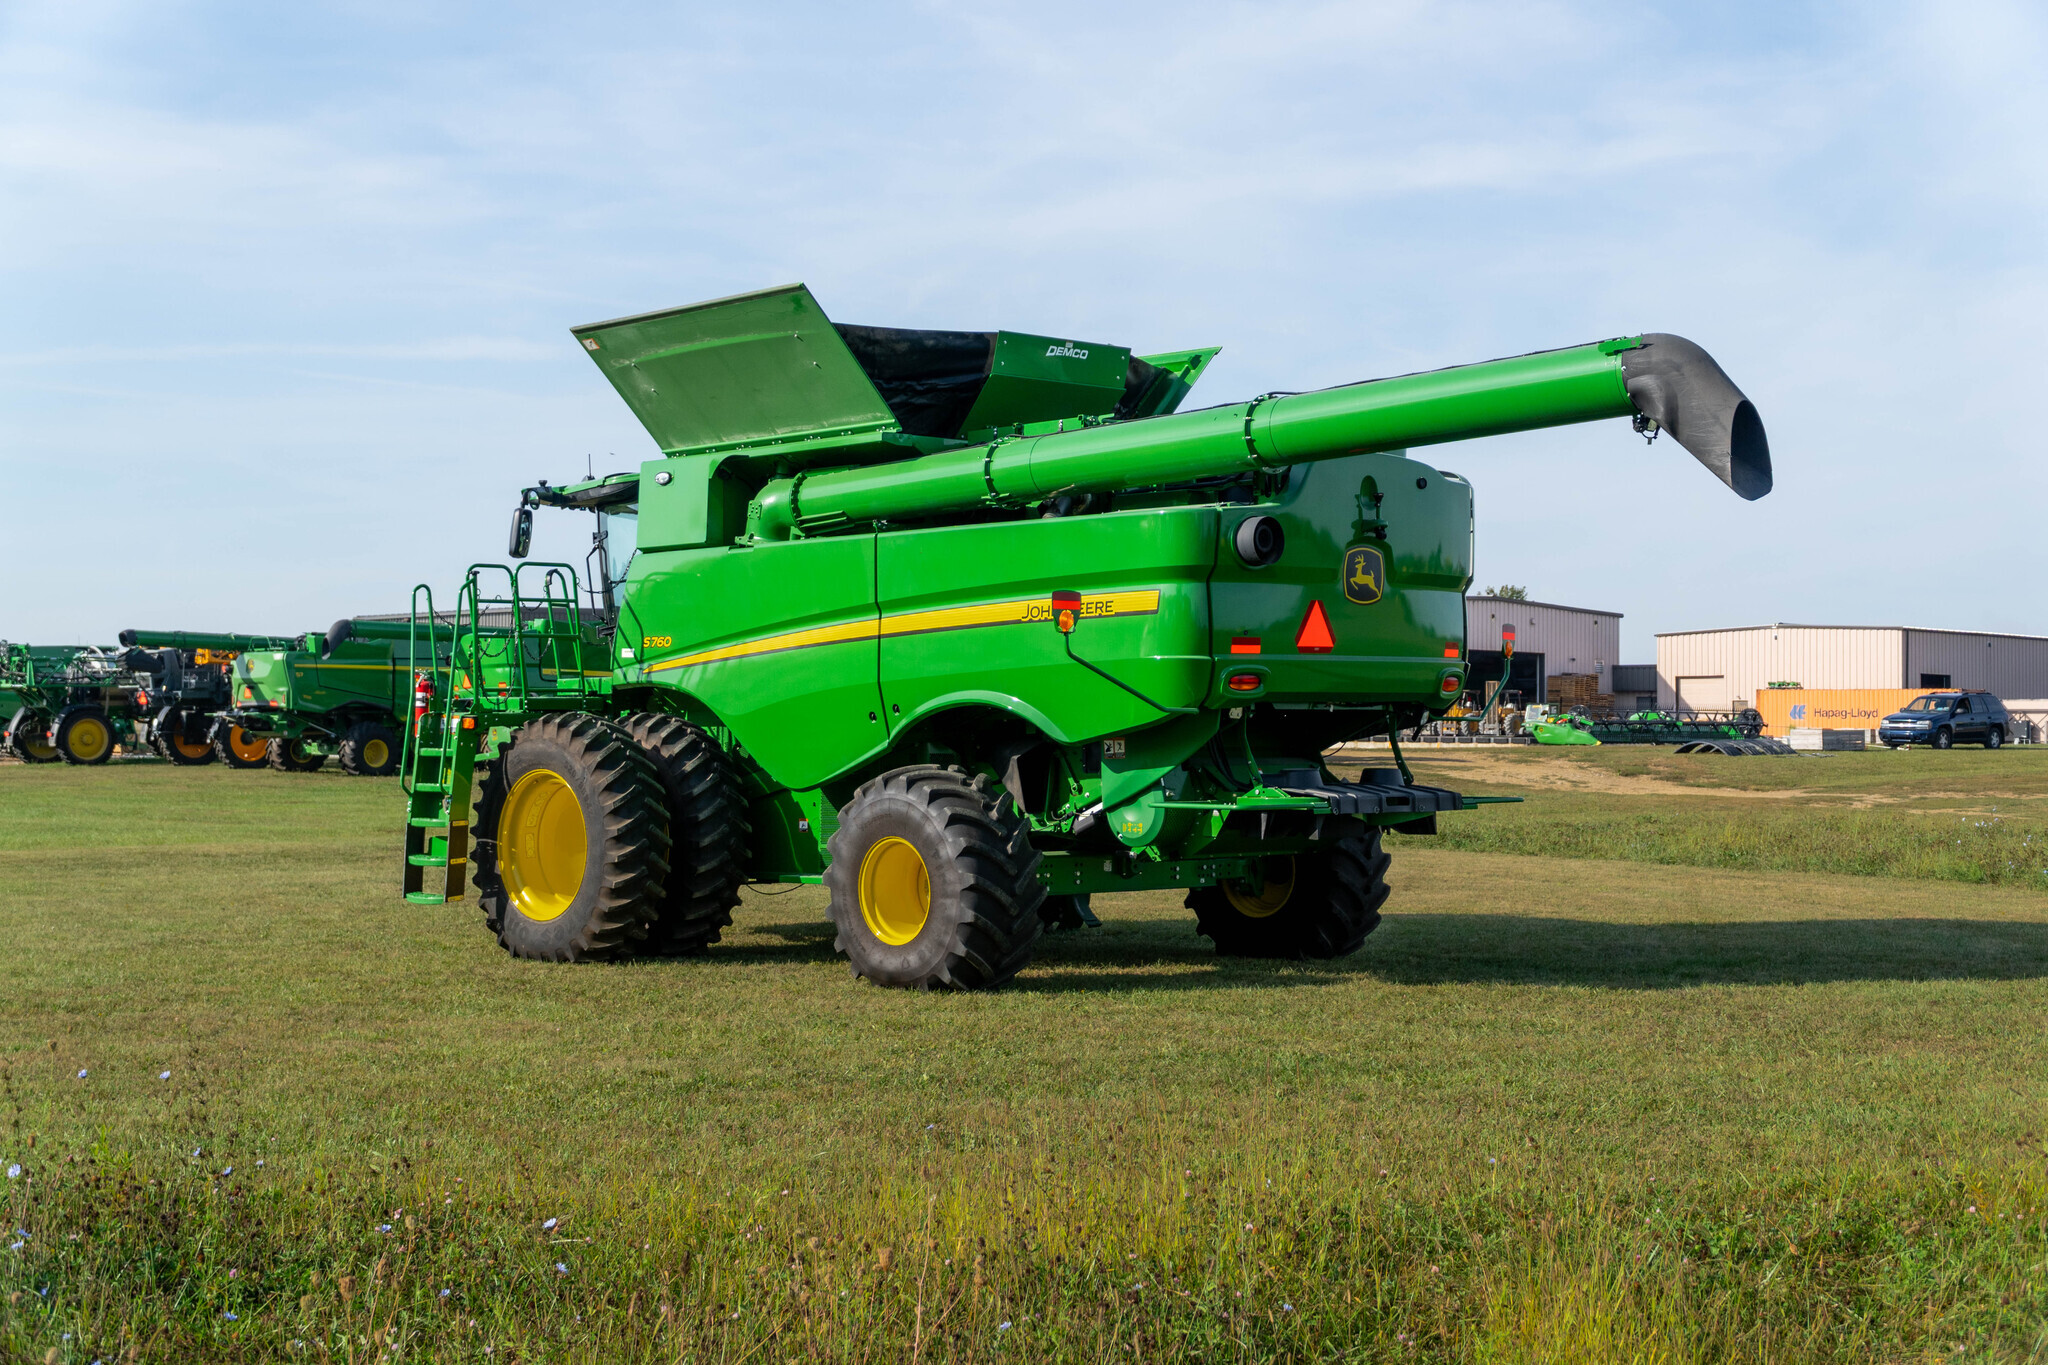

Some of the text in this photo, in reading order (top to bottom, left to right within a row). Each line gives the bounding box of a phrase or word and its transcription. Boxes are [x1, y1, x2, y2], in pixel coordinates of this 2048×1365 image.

[1045, 345, 1089, 360] DEMCO
[1021, 600, 1114, 619] JOH EERE
[643, 636, 672, 648] S760
[1814, 707, 1879, 720] Hapag-Lloyd
